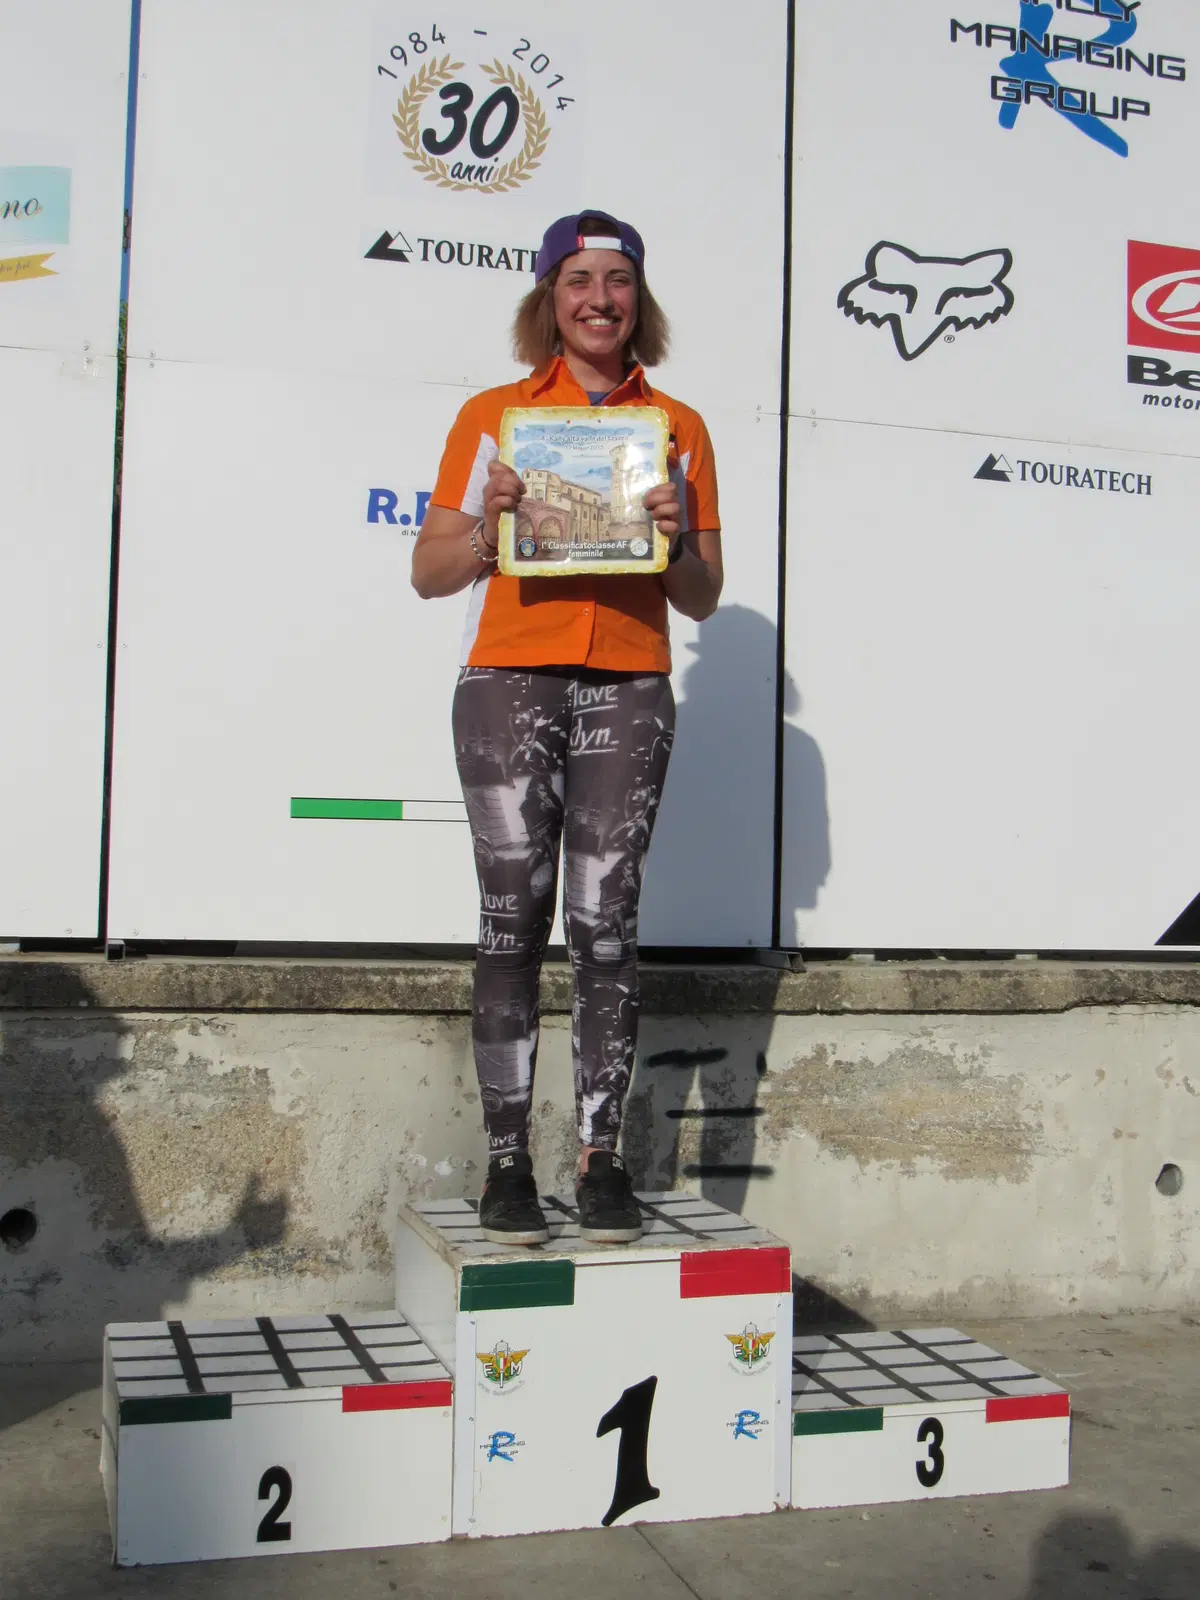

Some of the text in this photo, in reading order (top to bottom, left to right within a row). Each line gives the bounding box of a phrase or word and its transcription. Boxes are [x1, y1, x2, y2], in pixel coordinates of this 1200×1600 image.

[377, 24, 447, 79] 1984
[512, 38, 575, 111] 2014
[950, 18, 1186, 82] MANAGING
[422, 82, 520, 159] 30
[990, 75, 1150, 122] GROUP
[451, 157, 499, 183] anni
[1016, 460, 1152, 496] TOURATECH
[568, 550, 604, 558] femminile
[616, 541, 627, 549] AF
[481, 878, 520, 910] love
[596, 1375, 661, 1527] 1
[915, 1417, 944, 1488] 3
[256, 1465, 293, 1543] 2
